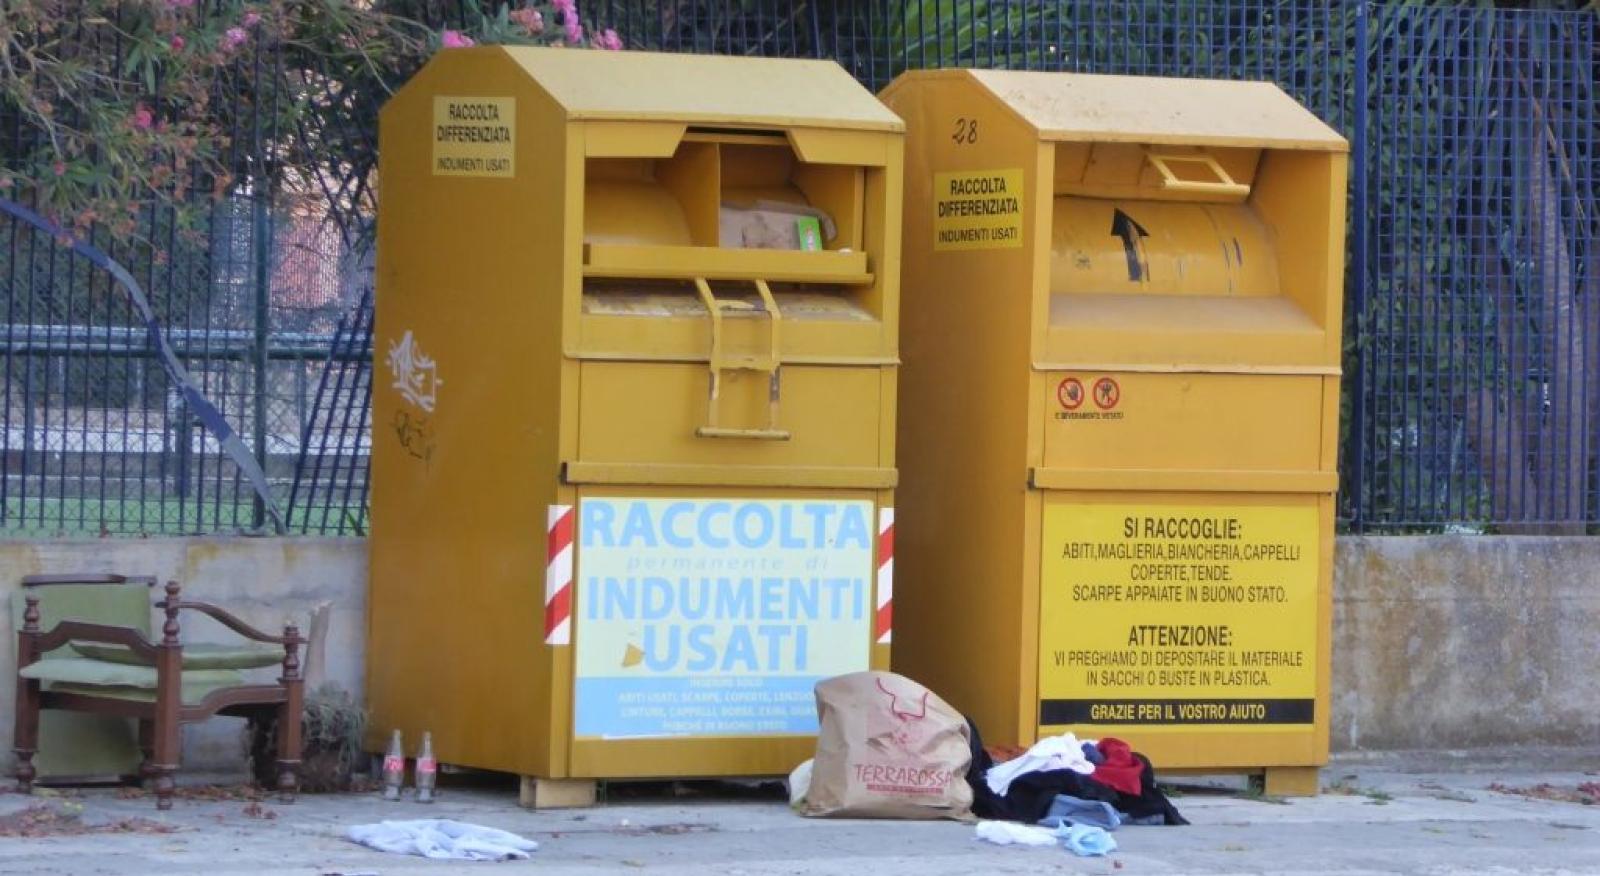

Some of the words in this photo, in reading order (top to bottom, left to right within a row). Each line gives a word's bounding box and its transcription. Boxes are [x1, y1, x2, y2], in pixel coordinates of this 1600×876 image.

[449, 103, 499, 120] RACCOLTA
[437, 125, 512, 142] DIFFERENZIATA
[952, 118, 978, 144] 28
[437, 157, 483, 171] INDUMENTI
[486, 157, 511, 171] USATI
[950, 177, 1007, 195] RACCOLTA
[938, 197, 1018, 217] DIFFERENZIATA
[938, 228, 989, 243] INDUMENTI
[992, 226, 1018, 240] USATI
[581, 500, 871, 549] RACCOLTA
[1124, 517, 1139, 538] SI
[1144, 518, 1242, 540] RACCOGLIE:
[627, 554, 784, 573] permanente
[805, 553, 829, 570] di
[587, 576, 864, 621] INDUMENTI
[1072, 585, 1122, 601] SCARPE
[1125, 586, 1182, 602] APPAIATE
[1186, 586, 1197, 602] IN
[1202, 586, 1244, 602] BUONO
[1247, 586, 1288, 603] STATO.
[1127, 625, 1232, 647] ATTENZIONE:
[643, 624, 808, 671] USATI
[1054, 651, 1066, 666] VI
[1068, 651, 1138, 666] PREGHIAMO
[1141, 652, 1153, 666] DI
[1155, 652, 1225, 667] DEPOSITARE
[1228, 652, 1239, 667] IL
[1241, 652, 1303, 667] MATERIALE
[1087, 670, 1099, 685] IN
[1101, 670, 1144, 686] SACCHI
[1147, 671, 1156, 685] O
[1159, 671, 1196, 686] BUSTE
[1199, 671, 1211, 686] IN
[1213, 671, 1271, 687] PLASTICA.
[1091, 704, 1135, 720] GRAZIE
[1138, 704, 1162, 719] PER
[1165, 705, 1175, 719] IL
[1179, 704, 1226, 719] VOSTRO
[1229, 704, 1265, 719] AIUTO
[853, 763, 954, 787] TERRAROSSA
